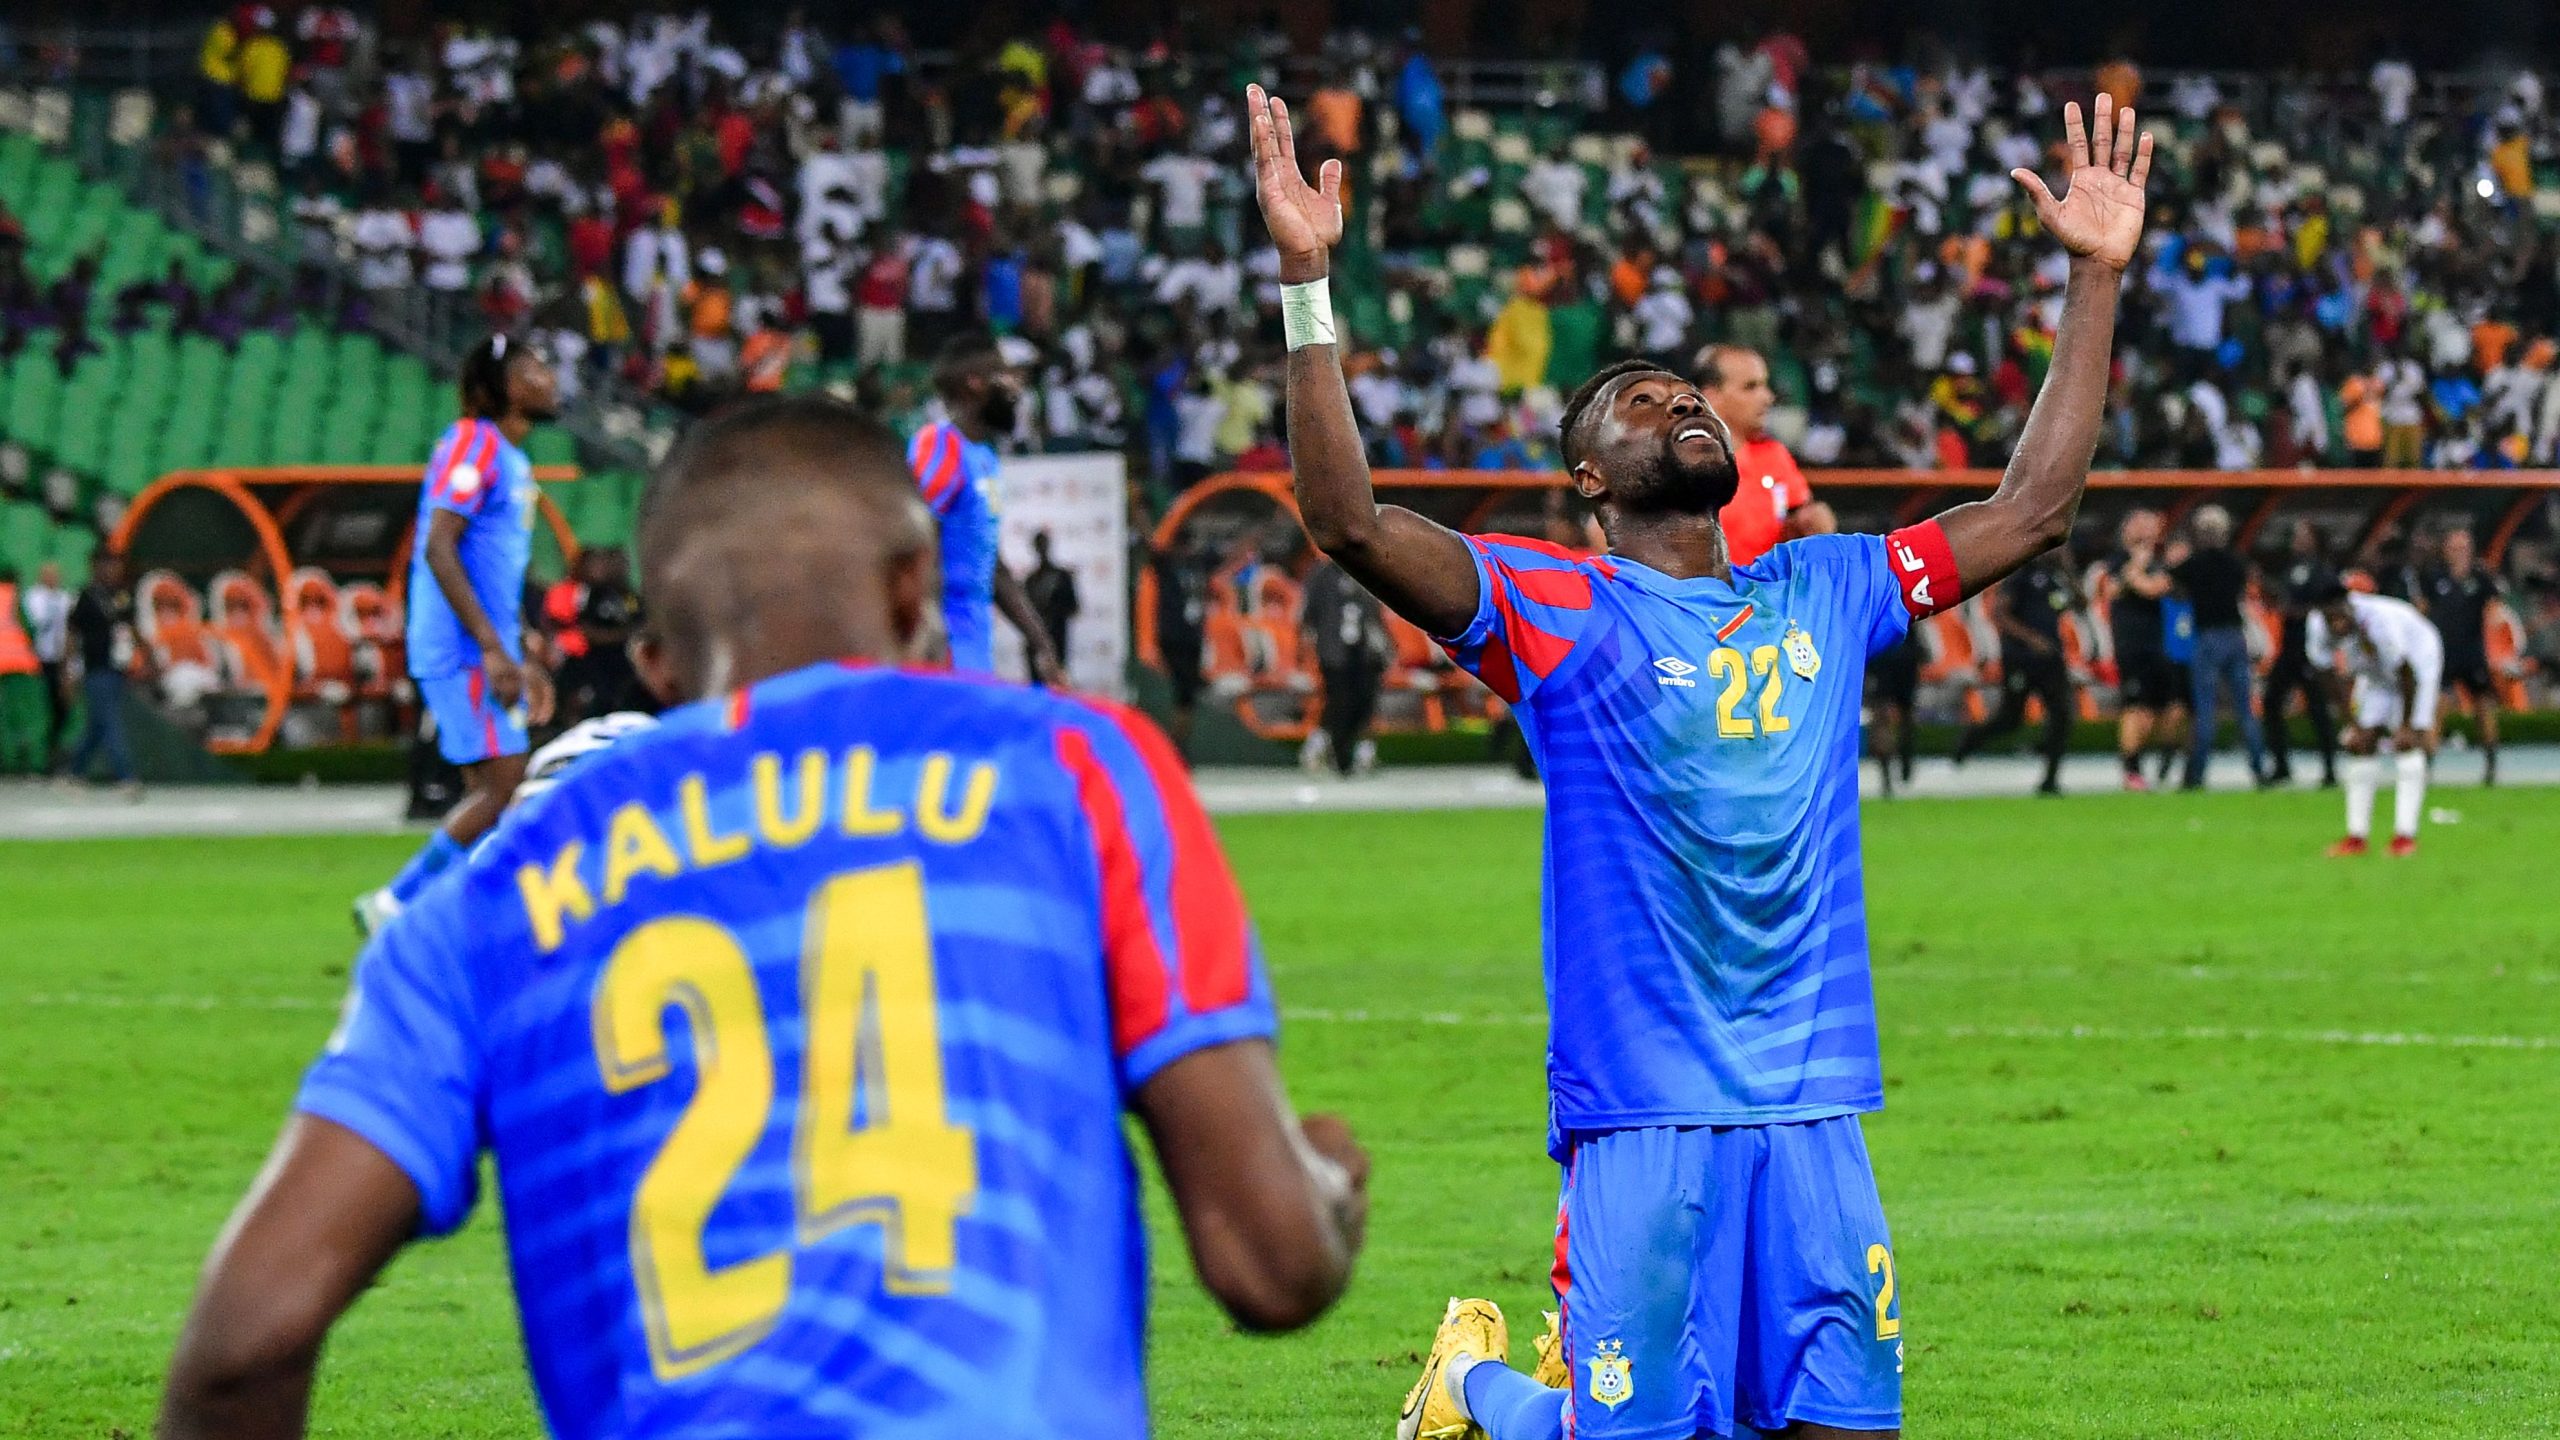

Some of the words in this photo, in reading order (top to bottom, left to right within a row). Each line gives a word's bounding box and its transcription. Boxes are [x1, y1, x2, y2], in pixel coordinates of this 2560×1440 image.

[1896, 545, 1934, 619] AF
[1658, 676, 1696, 688] umbro
[1708, 646, 1790, 738] 22
[517, 746, 997, 953] KALULU
[593, 859, 977, 1382] 24
